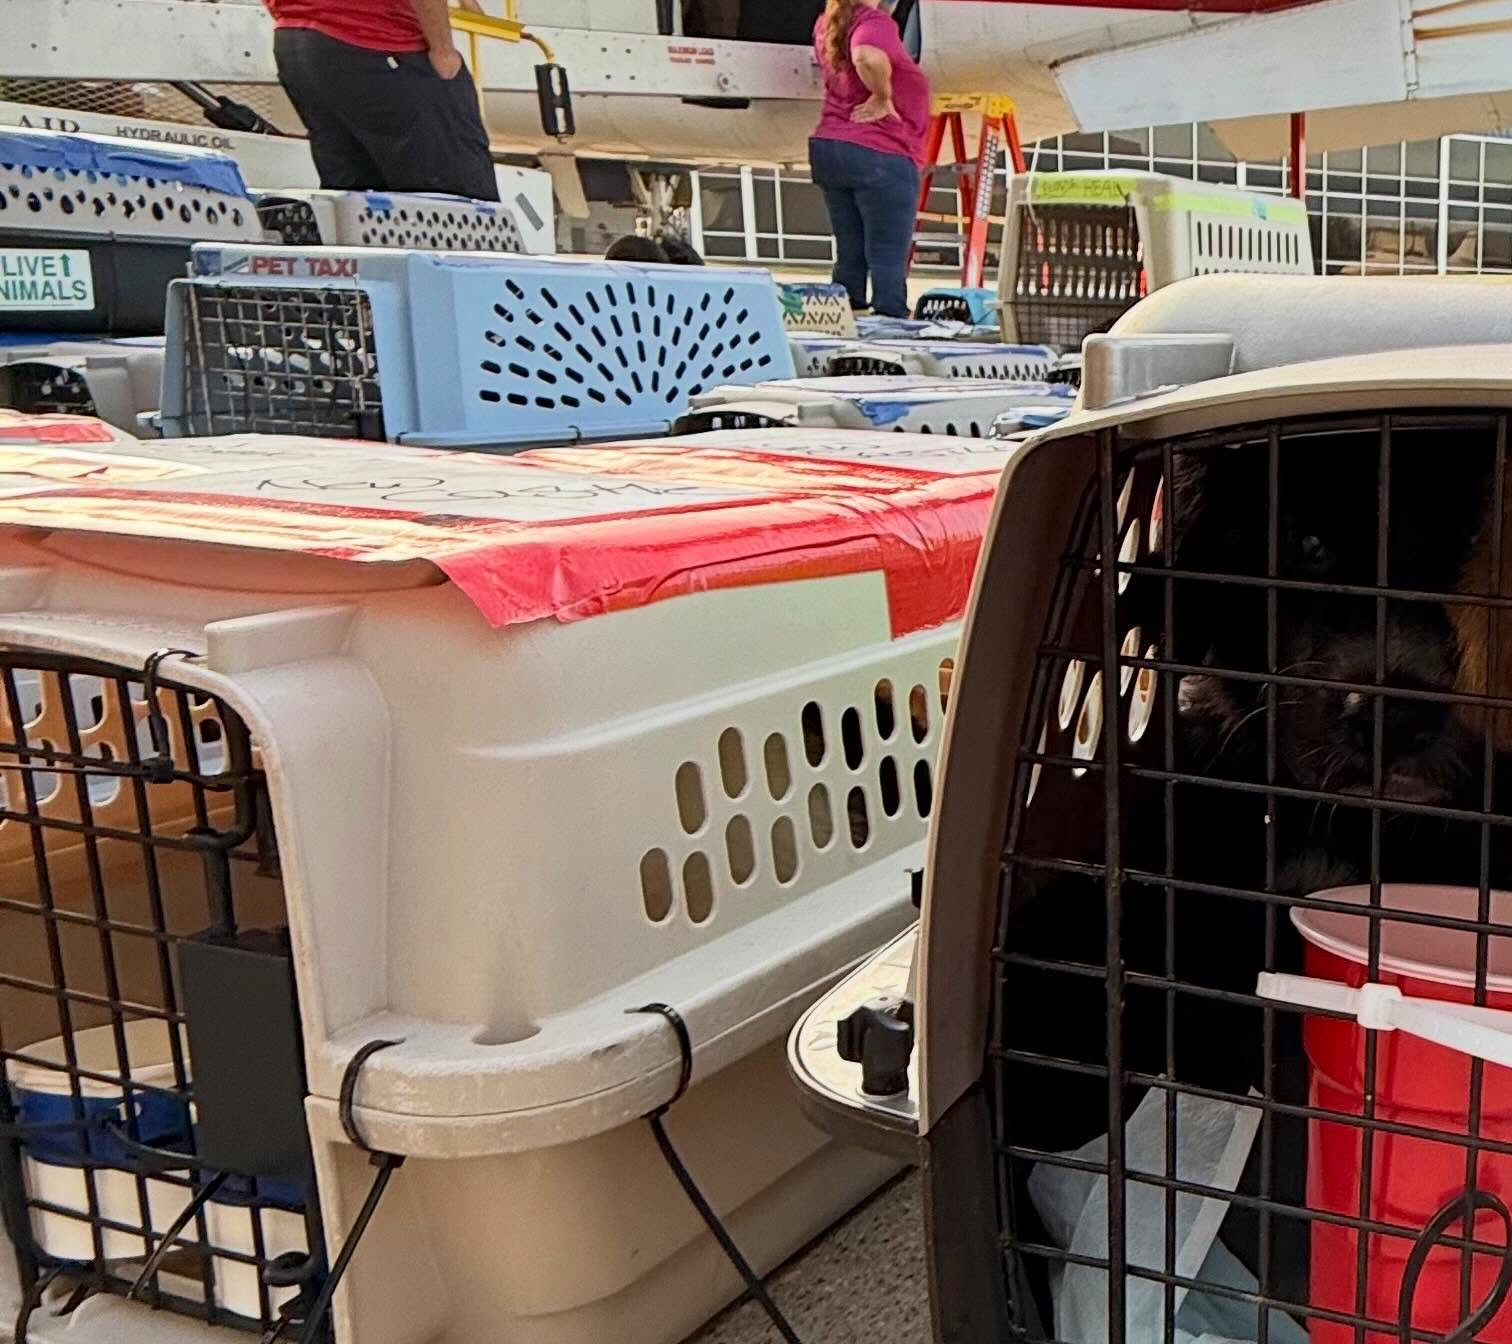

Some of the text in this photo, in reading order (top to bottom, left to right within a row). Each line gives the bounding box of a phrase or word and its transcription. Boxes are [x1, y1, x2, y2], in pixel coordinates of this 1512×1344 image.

[115, 125, 209, 148] HYDRAULIC
[1, 255, 56, 277] LIVE
[251, 256, 358, 277] PET TAXI
[0, 279, 87, 301] NIMALS
